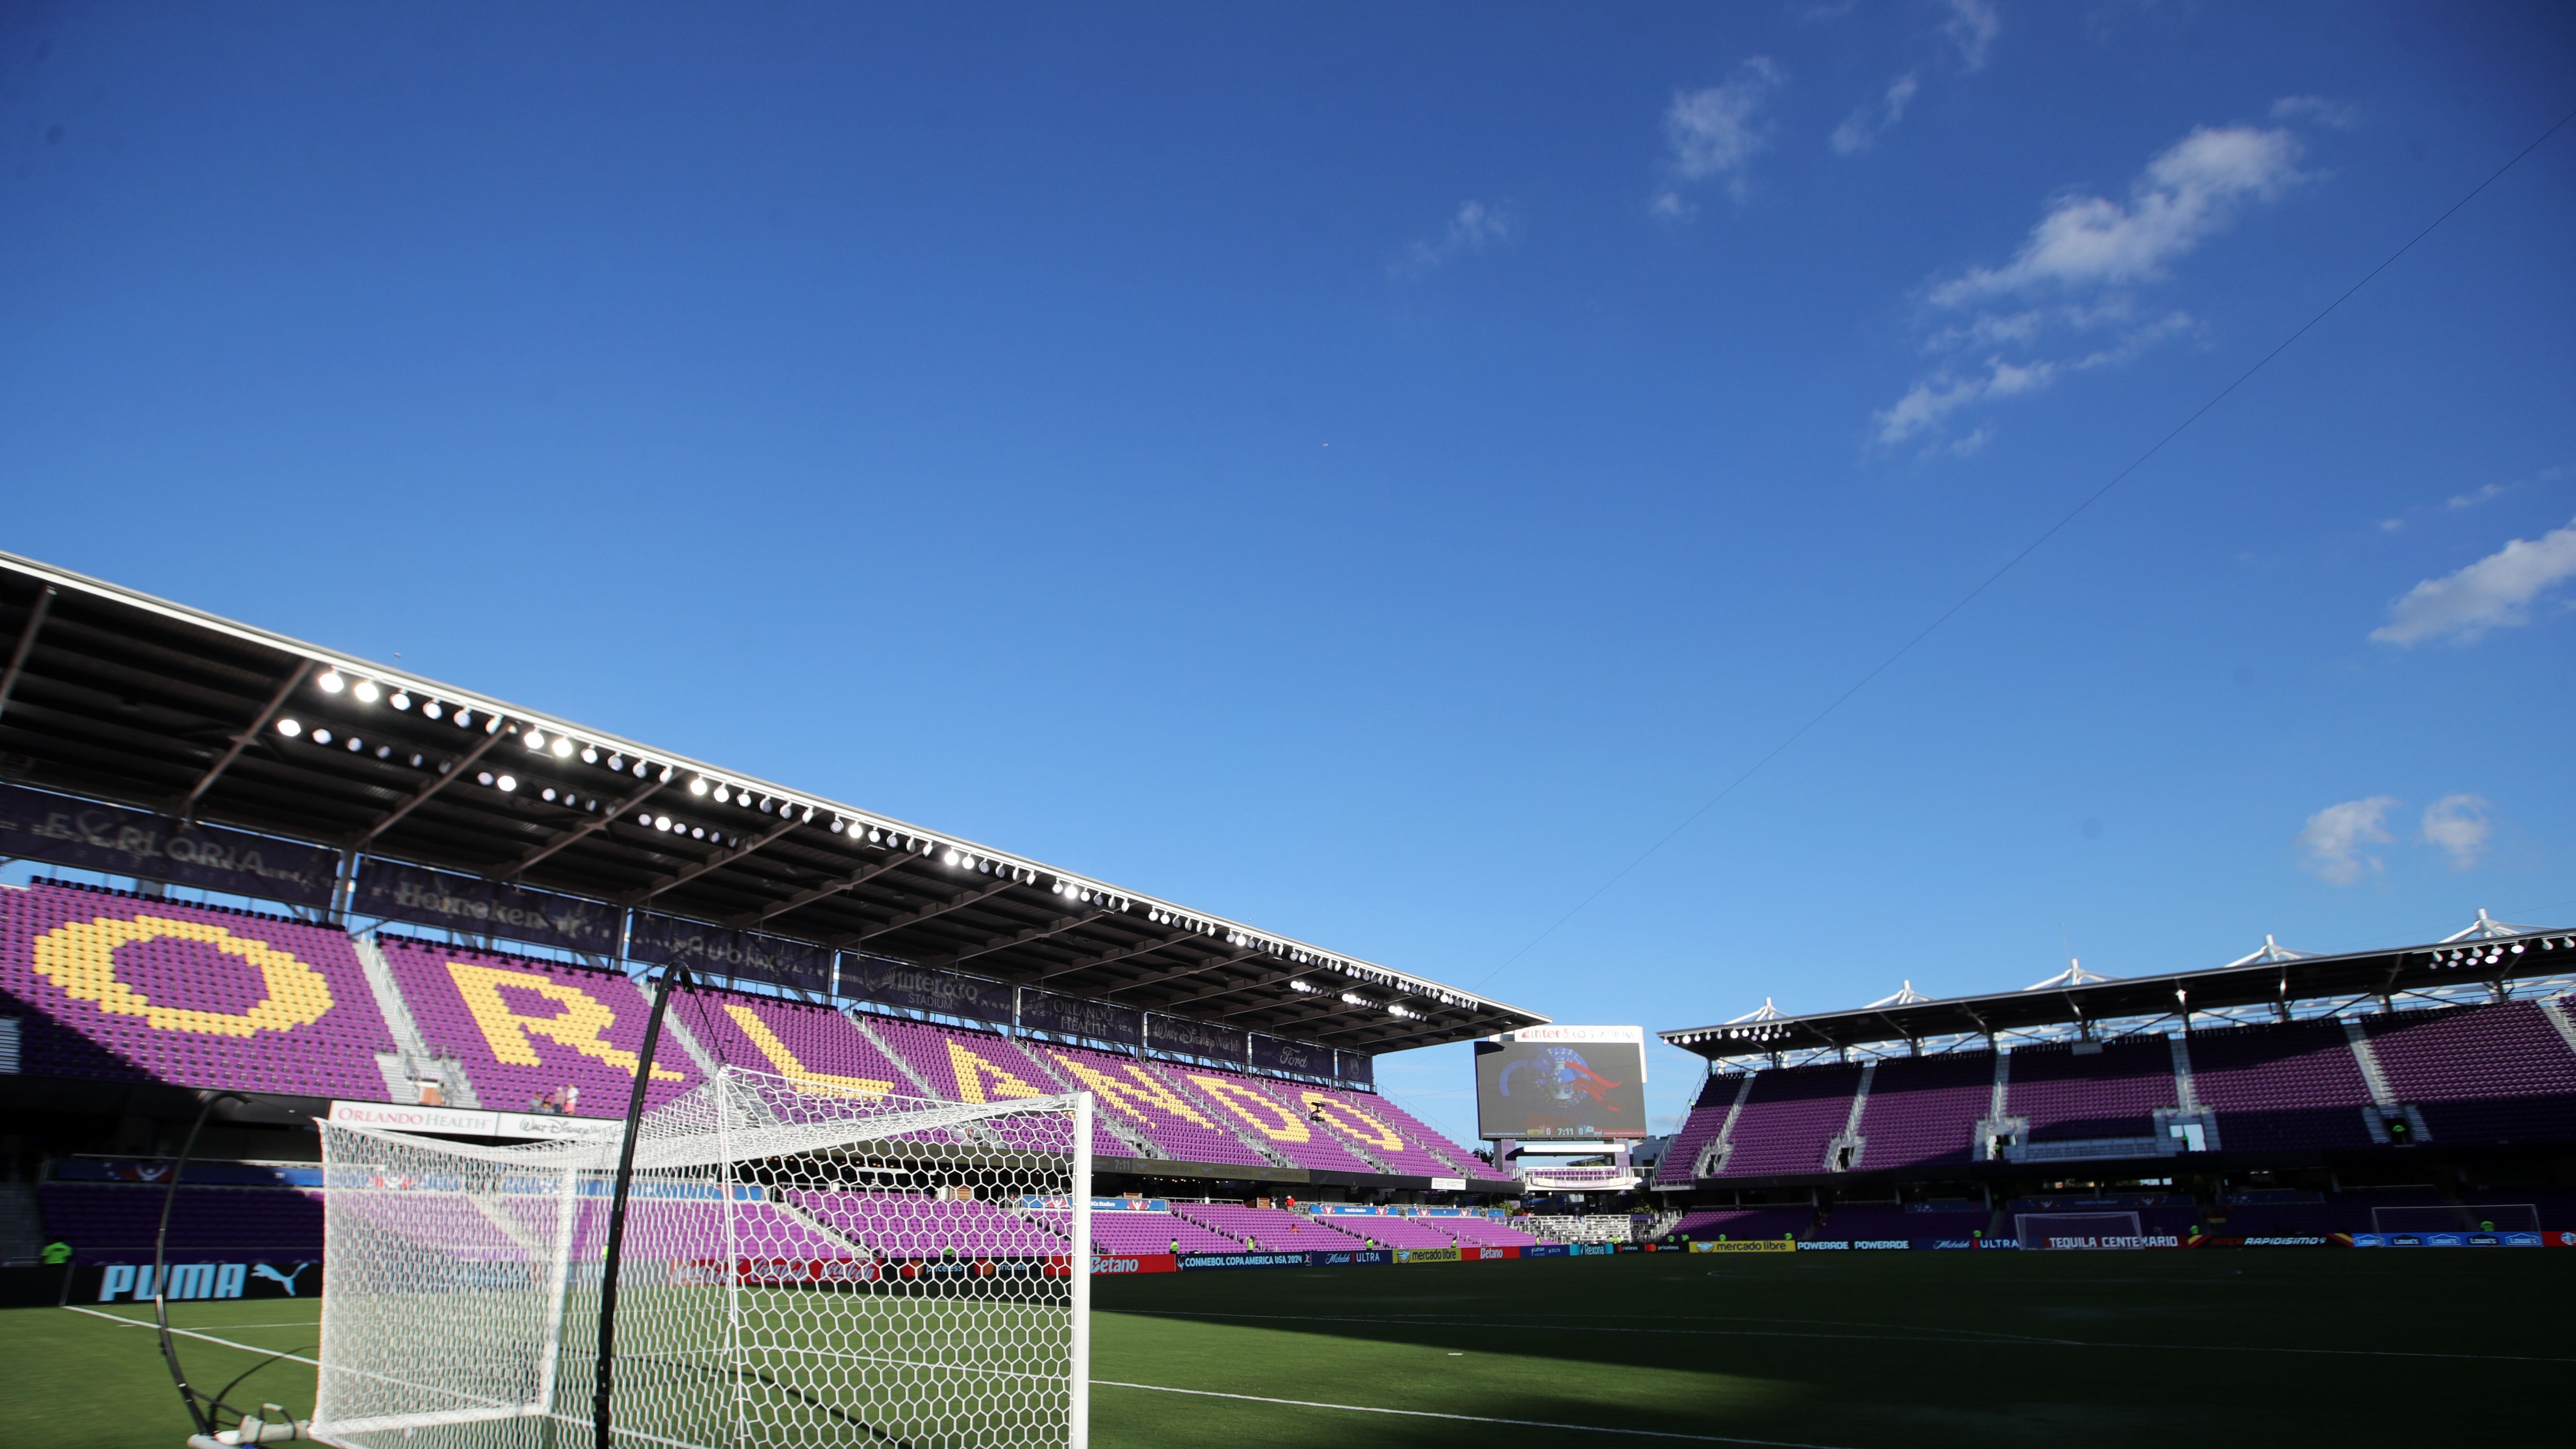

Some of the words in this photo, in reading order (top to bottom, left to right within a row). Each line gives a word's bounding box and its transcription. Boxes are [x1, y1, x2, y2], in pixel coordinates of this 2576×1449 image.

[395, 880, 549, 929] Heineken
[687, 935, 776, 972] Publix
[908, 993, 953, 1010] STADIUM
[1053, 999, 1113, 1022] ORLANDO
[1060, 1015, 1108, 1037] HEALTH
[33, 914, 1404, 1151] ORLANDO
[1589, 1030, 1634, 1039] STADIUM
[1215, 1036, 1240, 1052] World
[1280, 1046, 1309, 1068] Ford
[338, 1107, 424, 1125] ORLANDO
[425, 1113, 484, 1130] HEALTH
[1545, 1127, 1551, 1136] 0
[1578, 1127, 1583, 1136] 0
[1115, 1160, 1130, 1170] 7:11
[1179, 1164, 1193, 1173] libre
[1717, 1242, 1762, 1250] mercado
[1763, 1241, 1786, 1250] libre
[1797, 1241, 1850, 1250] POWERADE
[1854, 1241, 1909, 1250] POWERADE
[1933, 1239, 1971, 1249] Michelob
[1979, 1239, 2020, 1248] ULTRA
[2049, 1237, 2097, 1249] TEQUILA
[1412, 1250, 1441, 1261] mercado
[1442, 1249, 1456, 1260] libre
[1481, 1248, 1503, 1259] Betano
[1584, 1245, 1605, 1255] Rexona
[1185, 1257, 1225, 1267] CONMEBOL
[1225, 1256, 1244, 1266] COPA
[1245, 1256, 1274, 1266] AMERICA
[1275, 1255, 1287, 1264] USA
[1287, 1255, 1302, 1264] 2024
[1325, 1253, 1351, 1264] Michelob
[1356, 1252, 1380, 1262] ULTRA
[1090, 1256, 1139, 1273] Betano
[98, 1264, 247, 1302] PUMA
